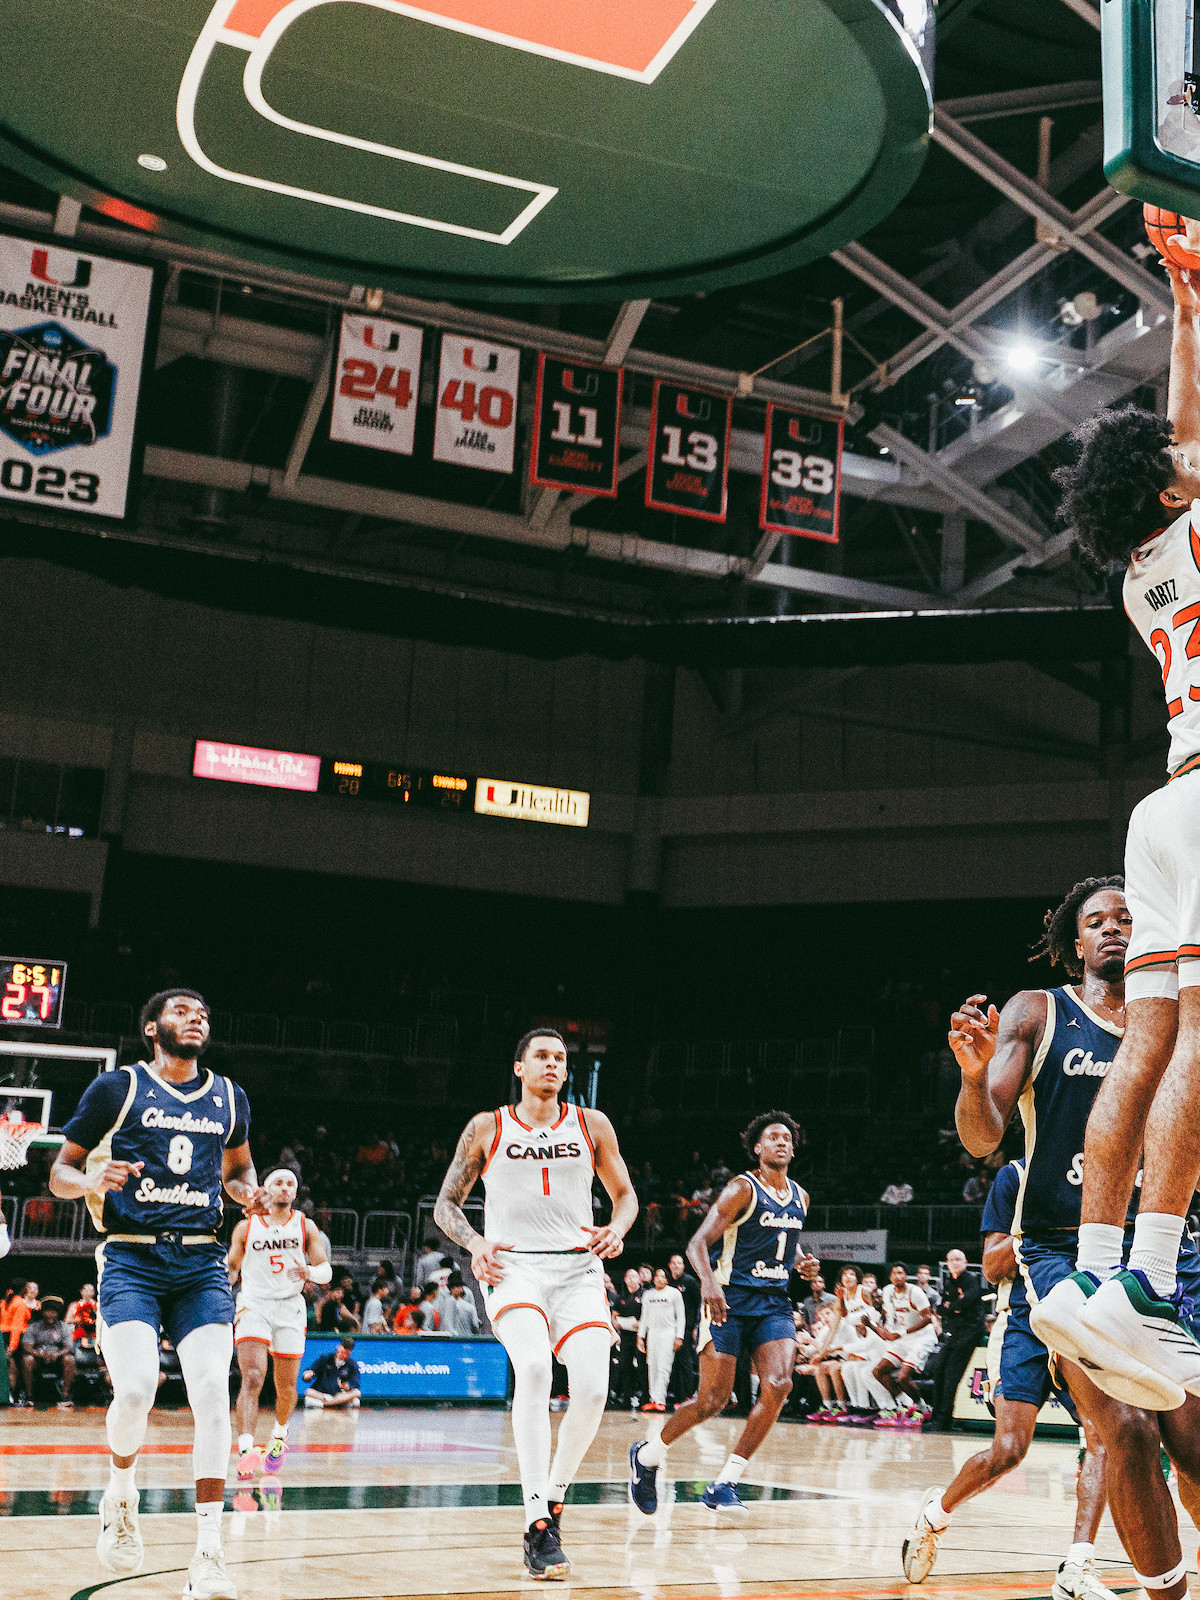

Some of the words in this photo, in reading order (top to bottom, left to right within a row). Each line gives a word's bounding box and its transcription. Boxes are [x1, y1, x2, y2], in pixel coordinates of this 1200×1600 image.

[2, 348, 93, 393] FINAL
[339, 358, 413, 409] 24
[6, 380, 97, 423] FOUR
[440, 379, 514, 429] 40
[551, 401, 603, 448] 11
[661, 425, 718, 473] 13
[1, 458, 100, 505] 023
[771, 449, 834, 494] 33
[12, 963, 60, 987] 6:51
[1, 982, 51, 1020] 27
[141, 1106, 225, 1136] Charleston
[166, 1134, 194, 1175] 8
[506, 1142, 581, 1161] CANES
[134, 1177, 210, 1208] Southern
[542, 1167, 551, 1196] 1
[252, 1237, 299, 1252] CANES
[270, 1254, 285, 1274] 5
[775, 1231, 787, 1261] 1
